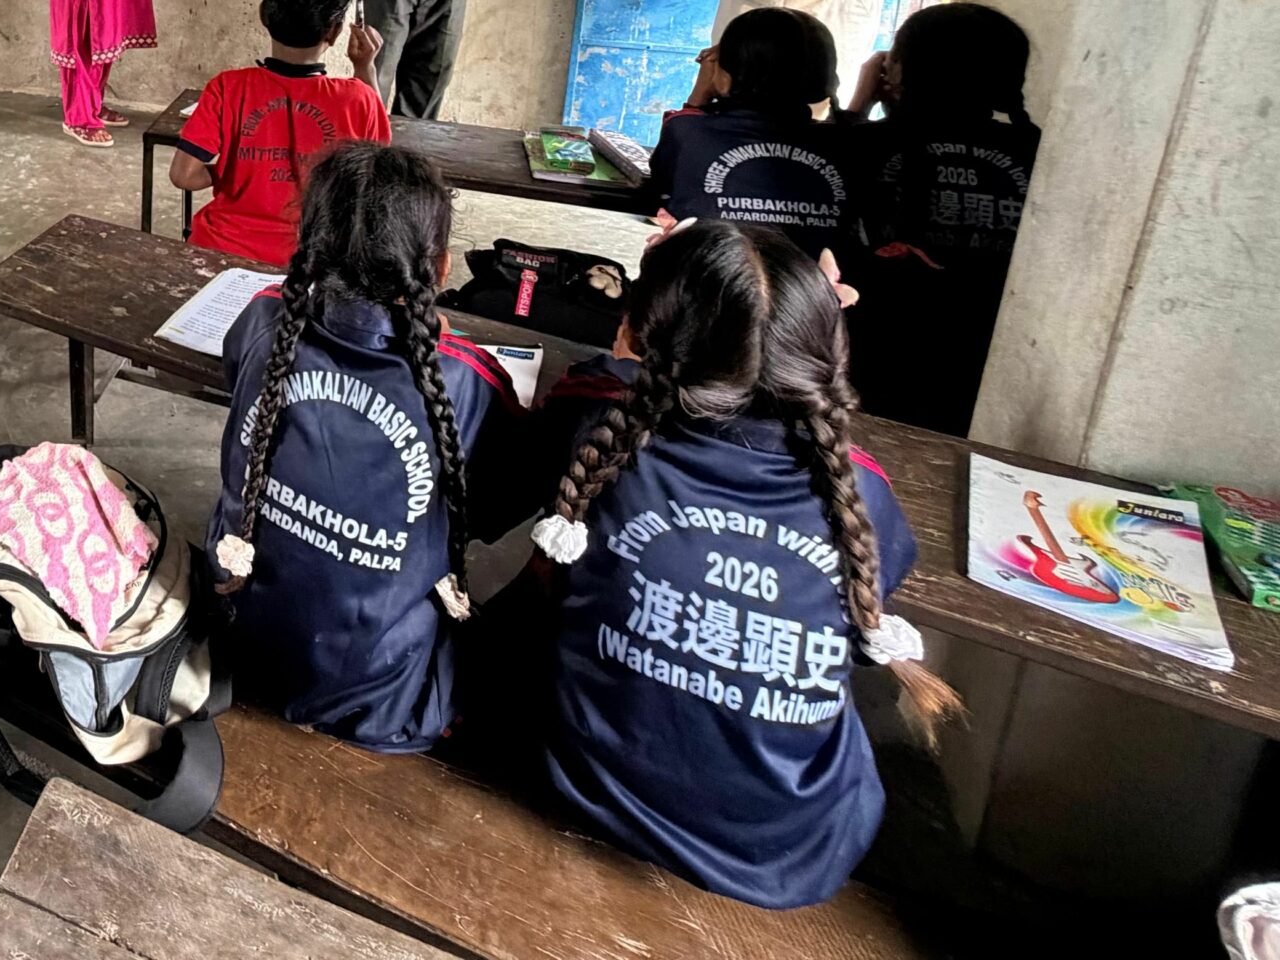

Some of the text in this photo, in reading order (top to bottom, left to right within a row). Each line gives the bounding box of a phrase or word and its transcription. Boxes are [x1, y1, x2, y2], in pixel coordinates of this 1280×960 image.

[704, 142, 846, 202] SHREE JANAKALYAN BASIC SCHOOL
[936, 165, 979, 186] 2026
[973, 147, 1013, 169] with
[717, 197, 841, 217] PURBAKHOLA-5
[720, 211, 838, 229] AAFARDANDA, PALPA
[516, 256, 540, 268] BAG
[282, 371, 373, 414] ANAKALYAN
[367, 393, 419, 449] BASIC
[400, 441, 434, 524] SCHOOL
[253, 470, 408, 551] RBAKHOLA-5
[606, 499, 840, 574] From Japan with
[348, 547, 403, 572] PALPA
[704, 551, 779, 603] 2026
[597, 622, 745, 711] (Watanabe
